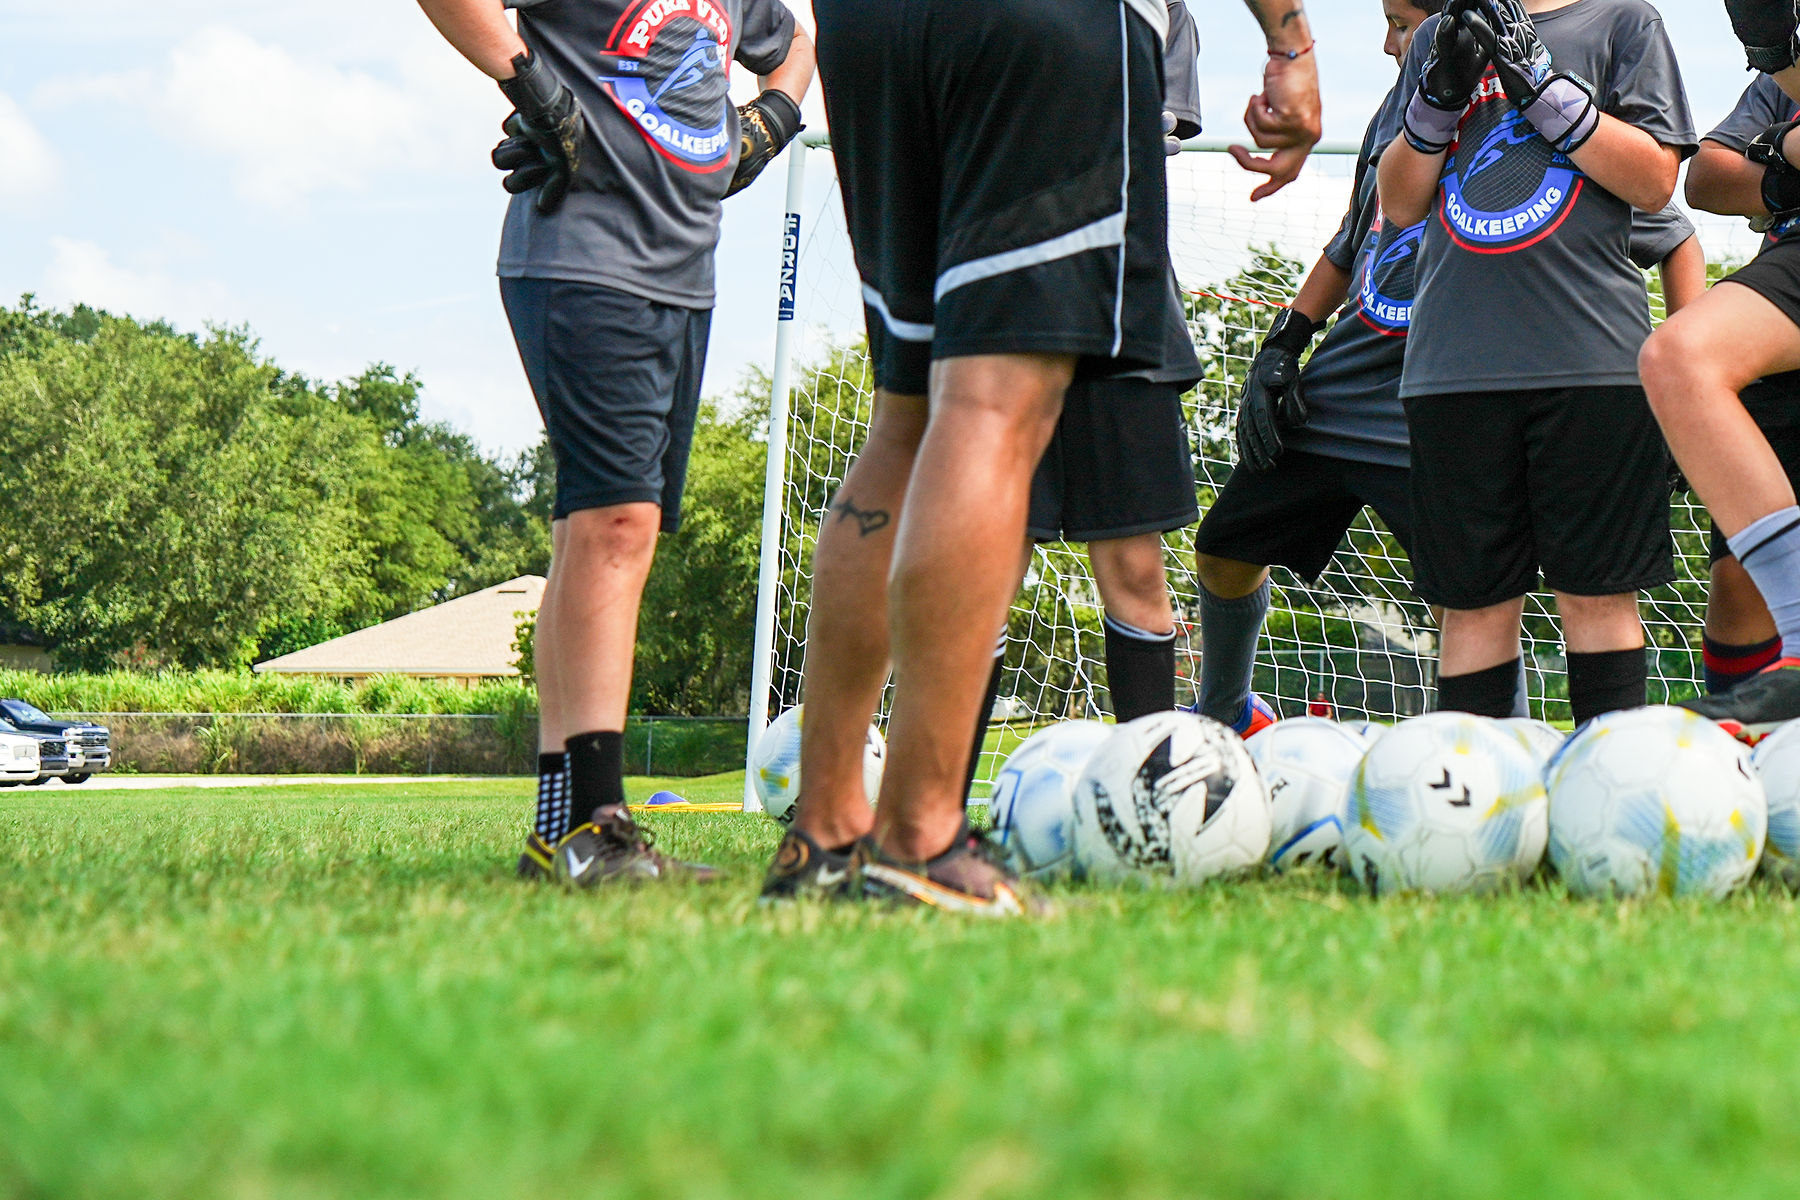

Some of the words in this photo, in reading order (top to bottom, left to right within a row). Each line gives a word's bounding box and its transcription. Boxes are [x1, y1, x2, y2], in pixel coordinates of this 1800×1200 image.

[617, 60, 639, 71] EST
[1447, 186, 1562, 236] GOALKEEPING
[780, 213, 799, 302] FORZA
